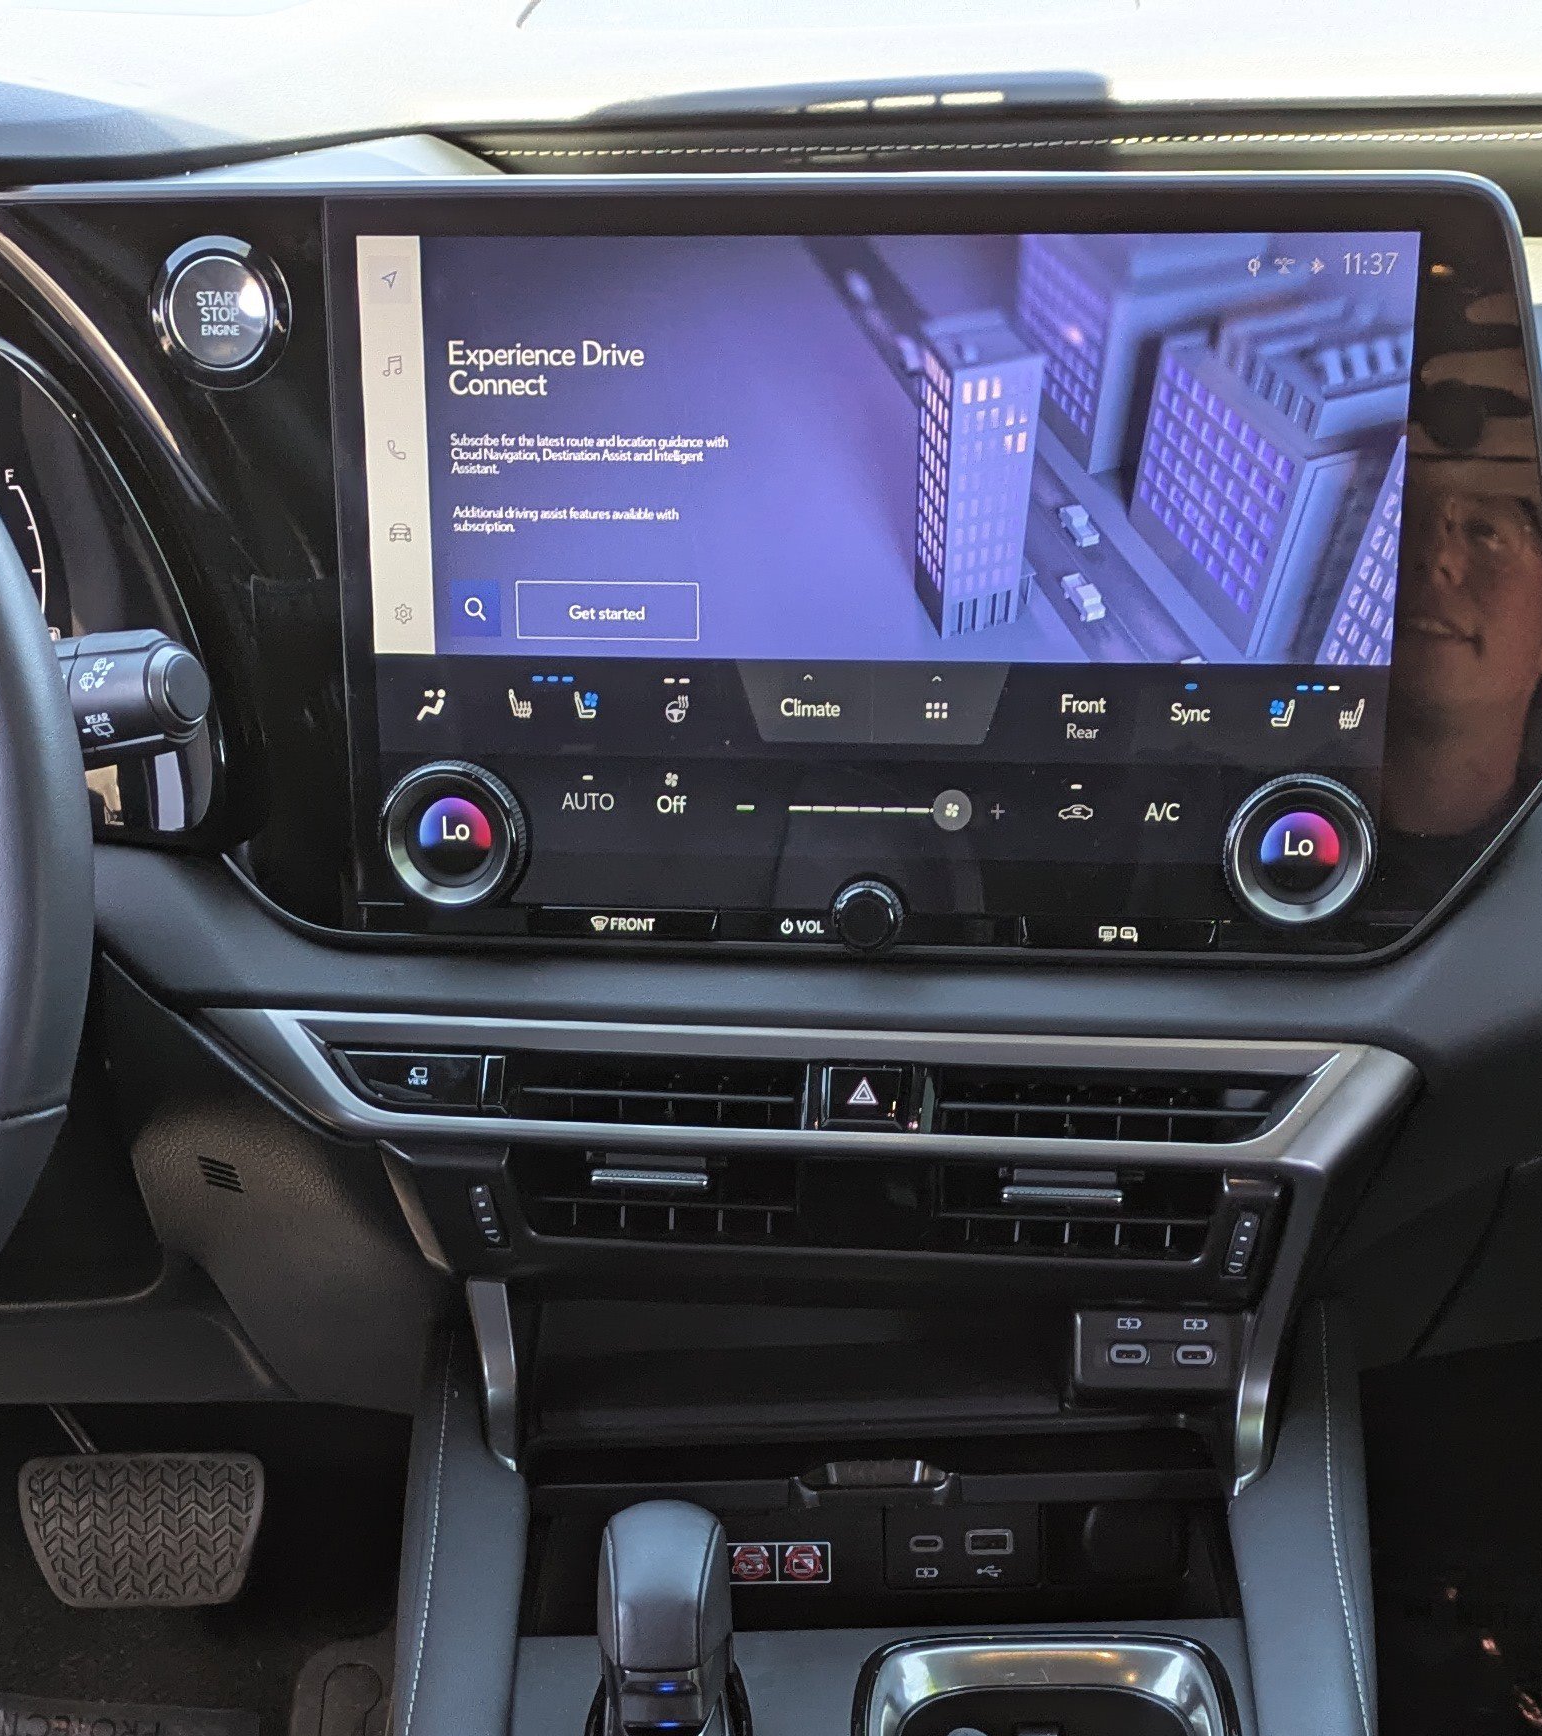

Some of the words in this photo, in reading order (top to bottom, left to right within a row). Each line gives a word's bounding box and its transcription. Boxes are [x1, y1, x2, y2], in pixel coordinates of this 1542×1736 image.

[1343, 252, 1399, 275] 11:37
[200, 306, 240, 322] STOP
[201, 324, 240, 336] ENGINE
[448, 339, 576, 371] Experience
[581, 340, 645, 367] Drive
[449, 371, 548, 397] Connect
[450, 433, 499, 446] Subscribe
[501, 434, 516, 446] for
[518, 434, 534, 446] the
[537, 434, 564, 447] latest
[566, 436, 594, 447] route
[596, 435, 616, 447] and
[617, 435, 656, 447] location
[658, 435, 704, 450] guidance
[706, 435, 729, 448] with
[450, 447, 482, 460] Cloud
[483, 448, 540, 463] Navigation,
[542, 448, 600, 461] Destination
[602, 449, 631, 461] Assist
[633, 449, 652, 461] and
[654, 449, 704, 464] Intelligent
[4, 469, 15, 483] F
[451, 461, 500, 474] Assistant.
[452, 505, 504, 519] Additional
[504, 506, 539, 522] driving
[540, 508, 567, 520] assist
[569, 507, 611, 520] features
[612, 508, 655, 521] available
[655, 508, 679, 521] with
[569, 605, 594, 621] Get
[598, 605, 646, 621] started
[780, 698, 841, 719] Climate
[1061, 693, 1107, 714] Front
[84, 712, 110, 725] REAR
[1170, 702, 1211, 725] Sync
[1065, 724, 1099, 740] Rear
[561, 792, 615, 811] AUTO
[656, 794, 688, 814] Off
[1144, 802, 1181, 824] A/C
[441, 816, 471, 841] Lo
[1284, 831, 1314, 857] Lo
[610, 917, 656, 932] FRONT
[796, 919, 825, 935] VOL
